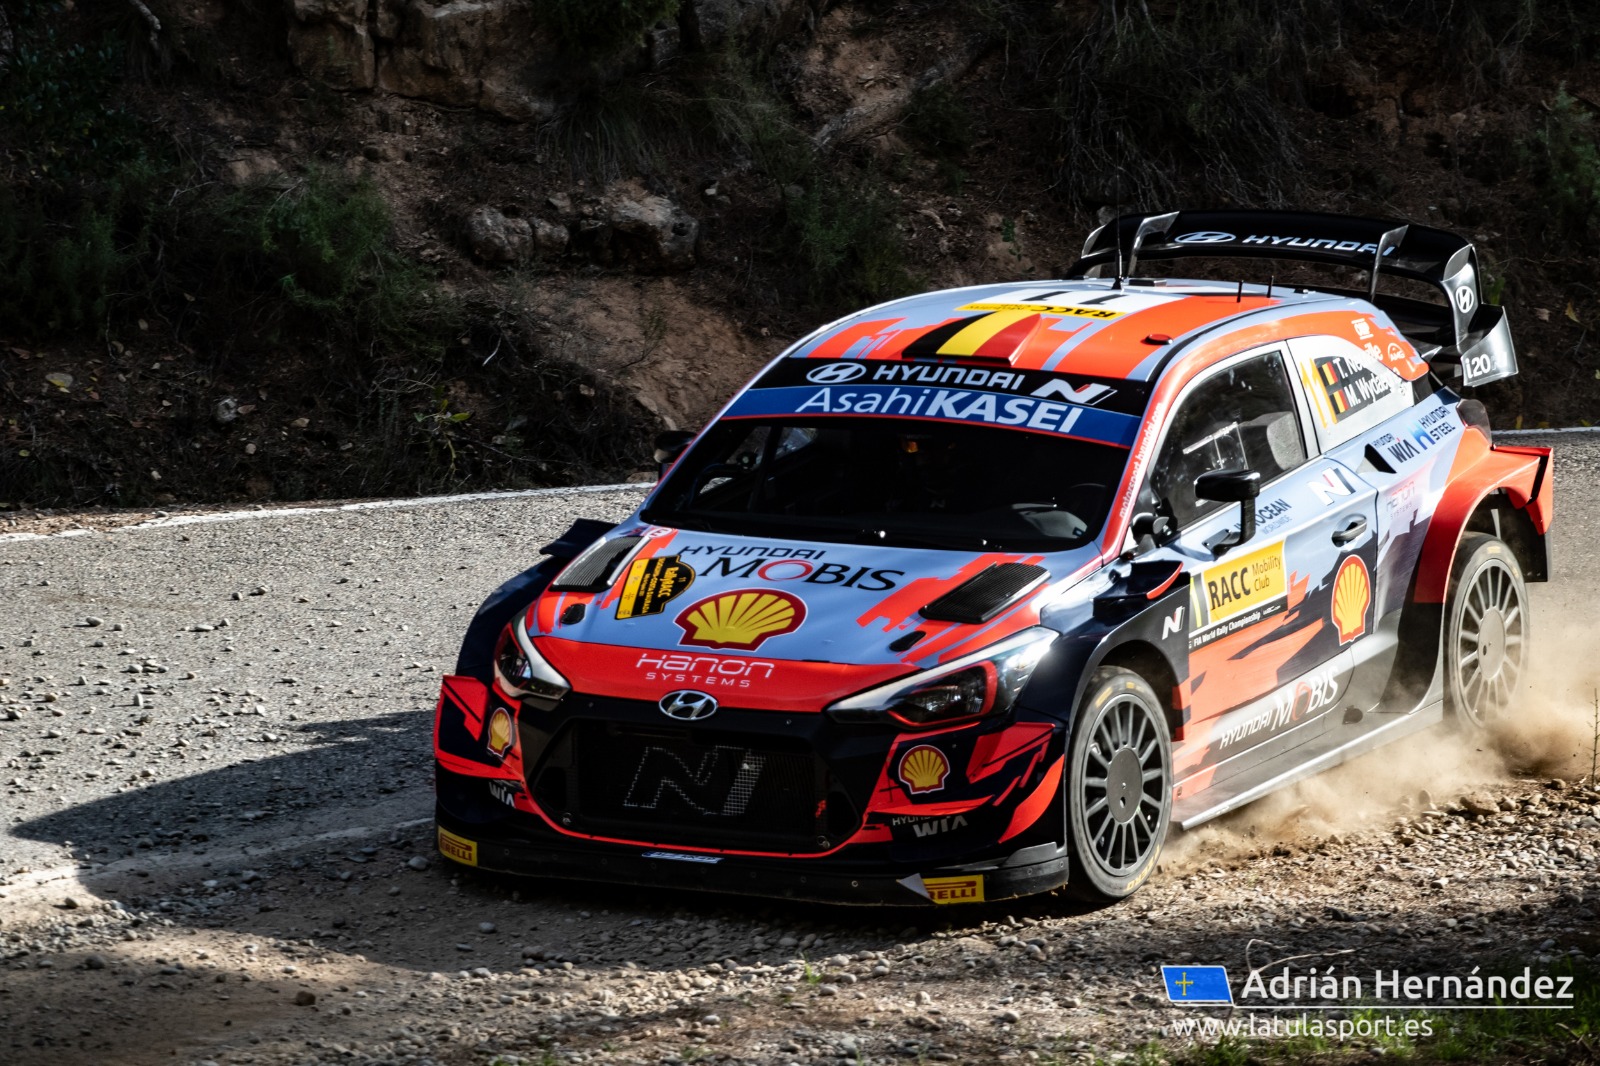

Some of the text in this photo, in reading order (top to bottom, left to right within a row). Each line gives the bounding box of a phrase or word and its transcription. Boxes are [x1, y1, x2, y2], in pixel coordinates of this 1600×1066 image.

[1241, 233, 1396, 257] HYUNDAI
[1030, 305, 1117, 318] RACC
[872, 364, 1026, 391] HYUNDAI
[1343, 383, 1362, 408] M.
[795, 387, 1084, 434] AsahiKASEI
[1418, 405, 1451, 429] HYUNDAI
[1429, 421, 1456, 441] STEEL
[1119, 401, 1164, 518] motorsport.hyundai.com
[1387, 437, 1421, 463] WIA
[676, 544, 828, 560] HYUNDAI
[698, 556, 907, 592] MOBIS
[1207, 555, 1281, 611] RACC Mobility
[1254, 575, 1271, 592] Club
[1202, 629, 1217, 644] World
[1228, 611, 1262, 632] Championship
[645, 671, 752, 689] SYSTEMS
[1219, 664, 1341, 751] HYUNDAI MOBIS
[912, 814, 969, 838] WIA
